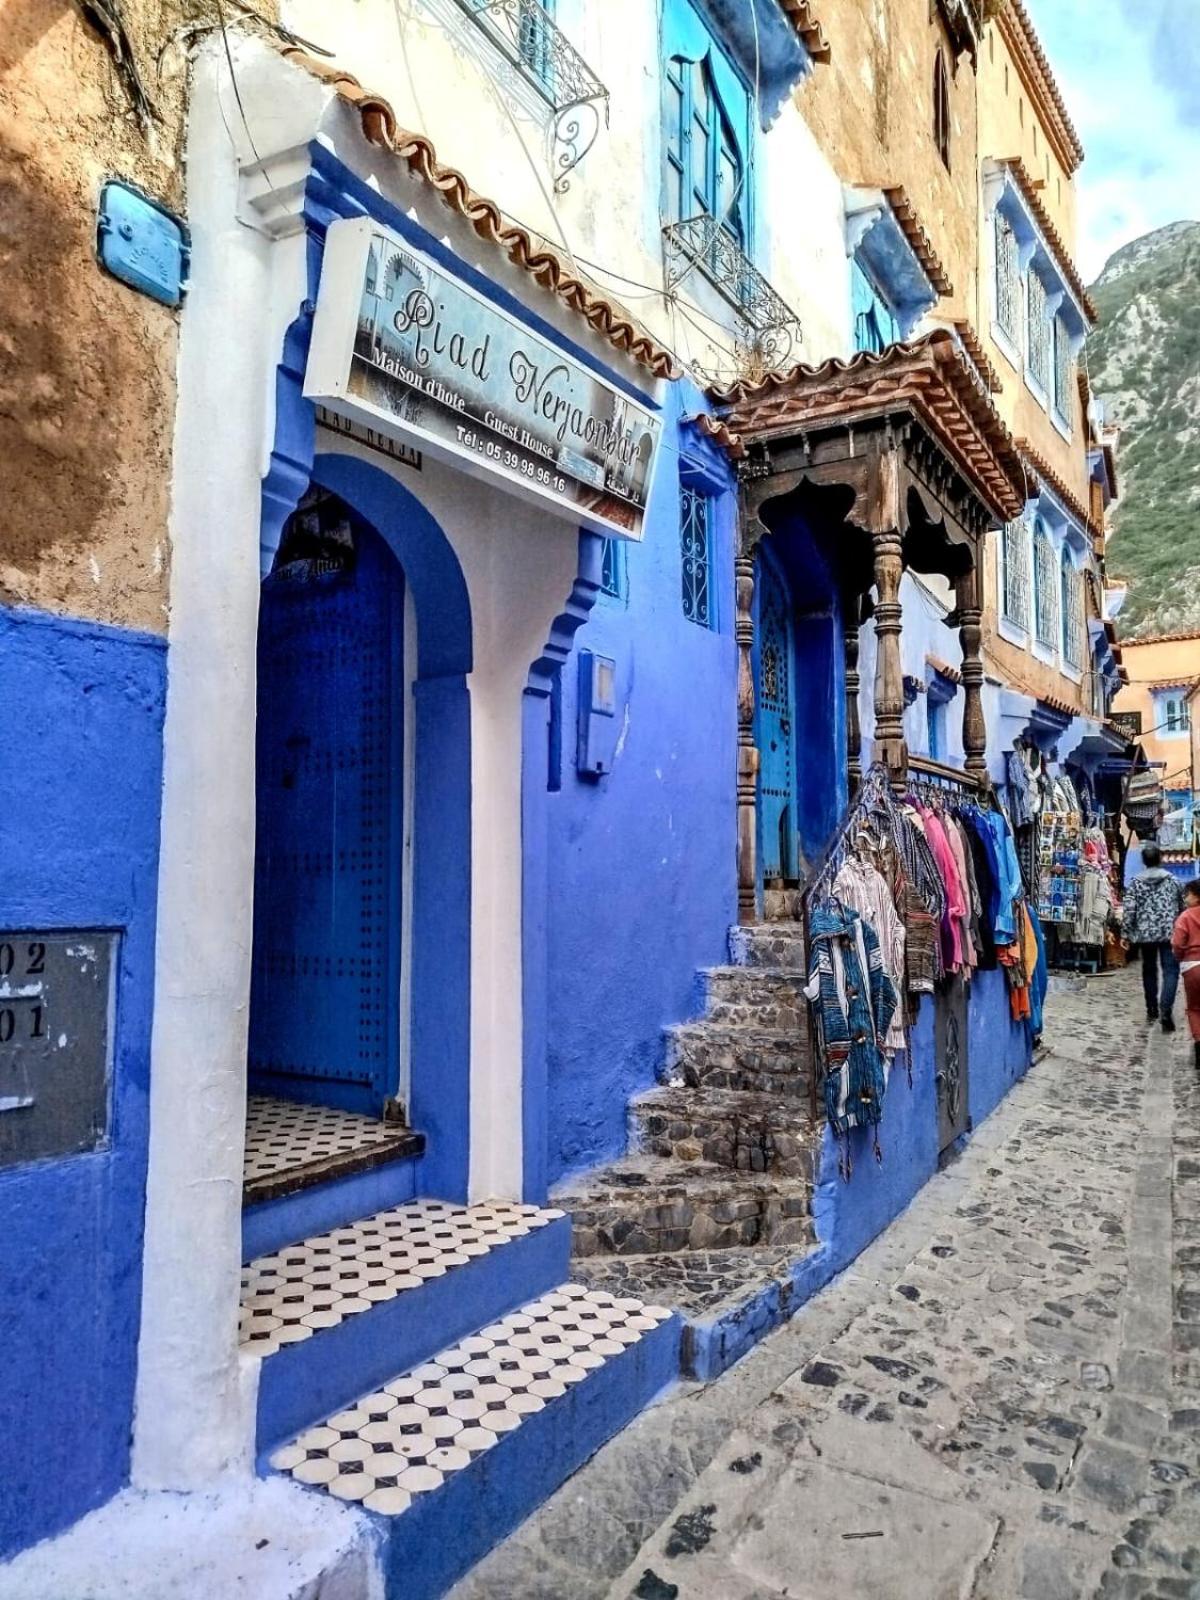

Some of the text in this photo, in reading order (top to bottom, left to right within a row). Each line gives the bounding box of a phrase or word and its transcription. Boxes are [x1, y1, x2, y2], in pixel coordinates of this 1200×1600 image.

[394, 289, 490, 382] Riad
[371, 346, 465, 411] Maison d'hote
[322, 406, 352, 432] IAD
[484, 410, 554, 458] Guest House
[486, 441, 502, 460] 05
[504, 450, 519, 468] 39
[521, 459, 535, 477] 98
[537, 468, 551, 484] 96
[553, 476, 566, 492] 16
